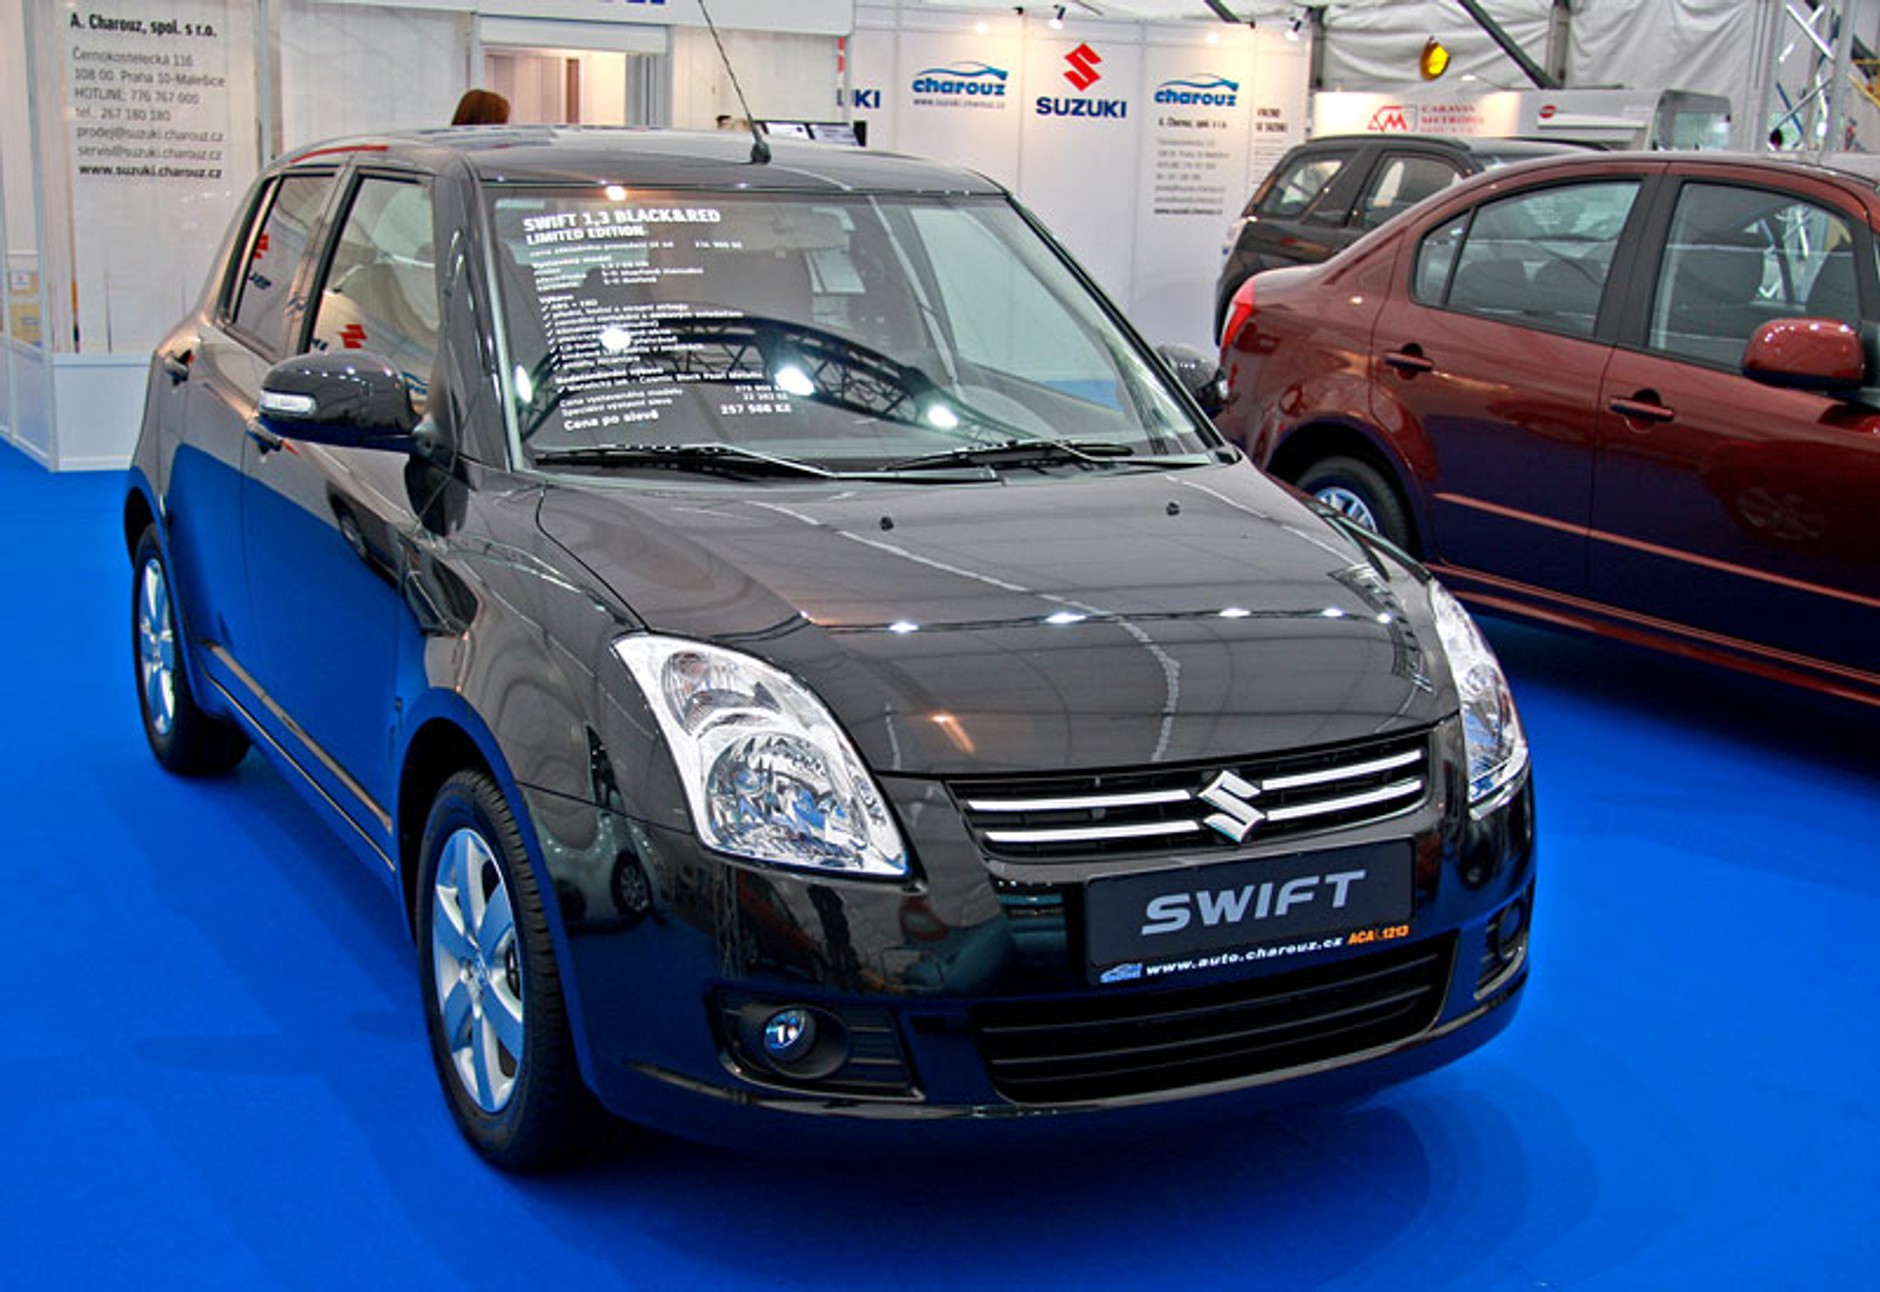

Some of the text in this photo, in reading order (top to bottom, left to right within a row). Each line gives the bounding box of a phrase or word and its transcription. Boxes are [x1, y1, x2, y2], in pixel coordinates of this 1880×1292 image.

[70, 12, 85, 28] A.
[89, 14, 147, 34] Charouz,
[150, 19, 182, 37] spol.
[185, 23, 192, 35] s
[75, 68, 96, 80] 108
[99, 69, 114, 81] 00
[120, 70, 154, 84] Praha
[75, 87, 127, 100] HOTLINE:
[912, 77, 1005, 96] charouz
[1035, 96, 1127, 118] SUZUKI
[1154, 88, 1237, 107] charouz
[79, 164, 222, 179] www.suzuki.charouz.cz
[523, 208, 721, 231] SWIFT 1,3 BLACK&RED
[526, 225, 646, 245] LIMITED EDITION
[564, 418, 599, 431] Cena
[602, 415, 620, 427] po
[1141, 869, 1366, 936] SWIFT
[1146, 936, 1343, 976] www.auto.charouz.cz
